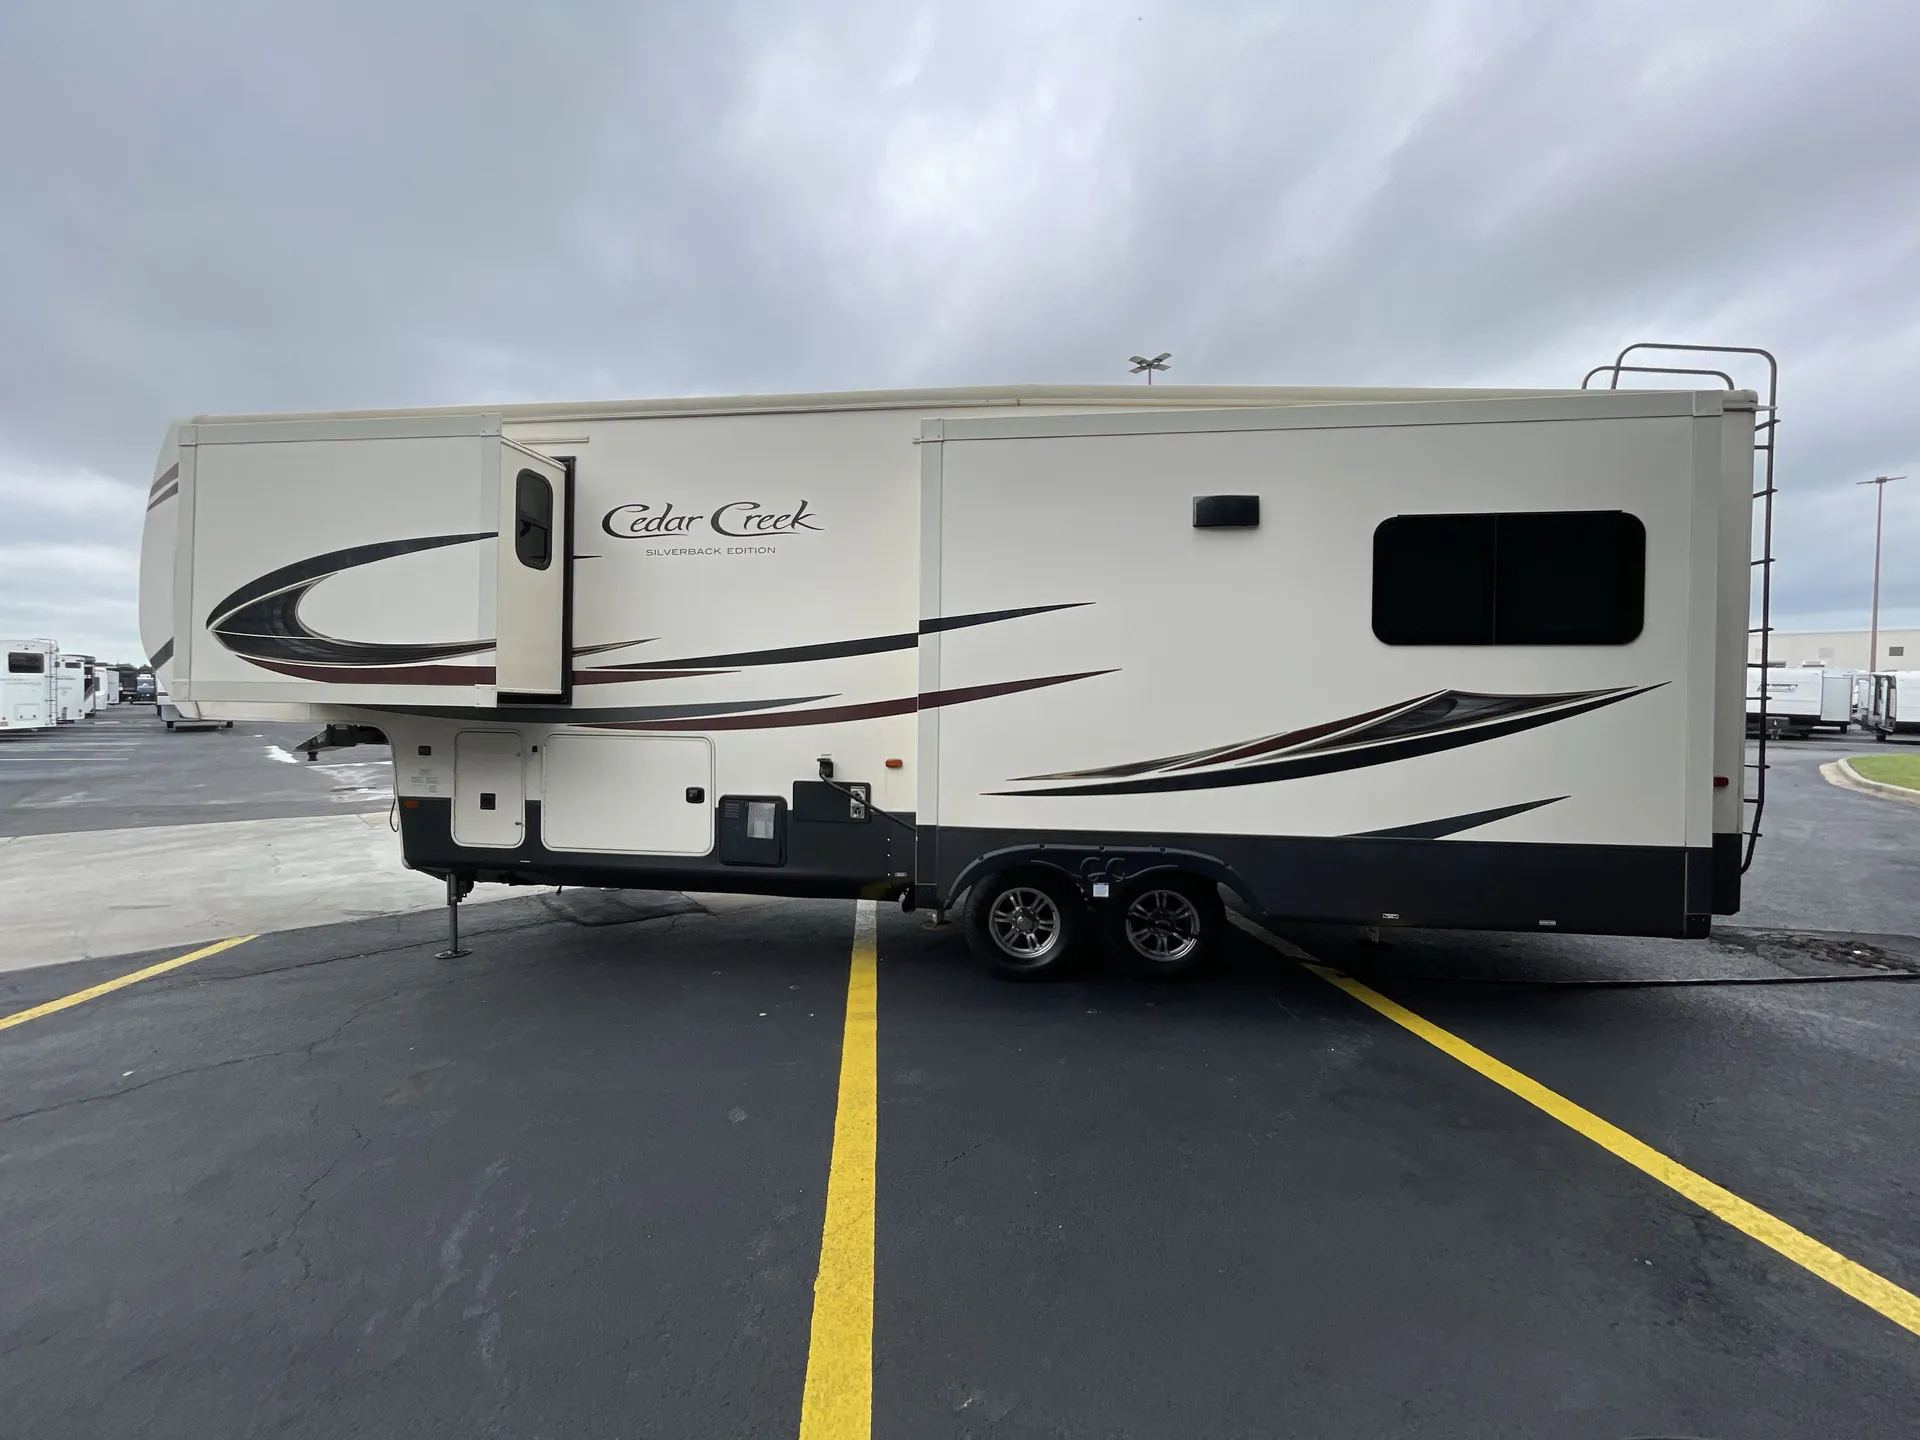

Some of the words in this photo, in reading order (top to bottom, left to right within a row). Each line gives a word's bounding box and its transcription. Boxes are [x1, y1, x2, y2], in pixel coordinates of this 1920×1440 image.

[602, 502, 704, 539] Cedar
[710, 499, 825, 537] Creek
[645, 547, 722, 558] SILVERBACK
[726, 546, 777, 556] EDITION
